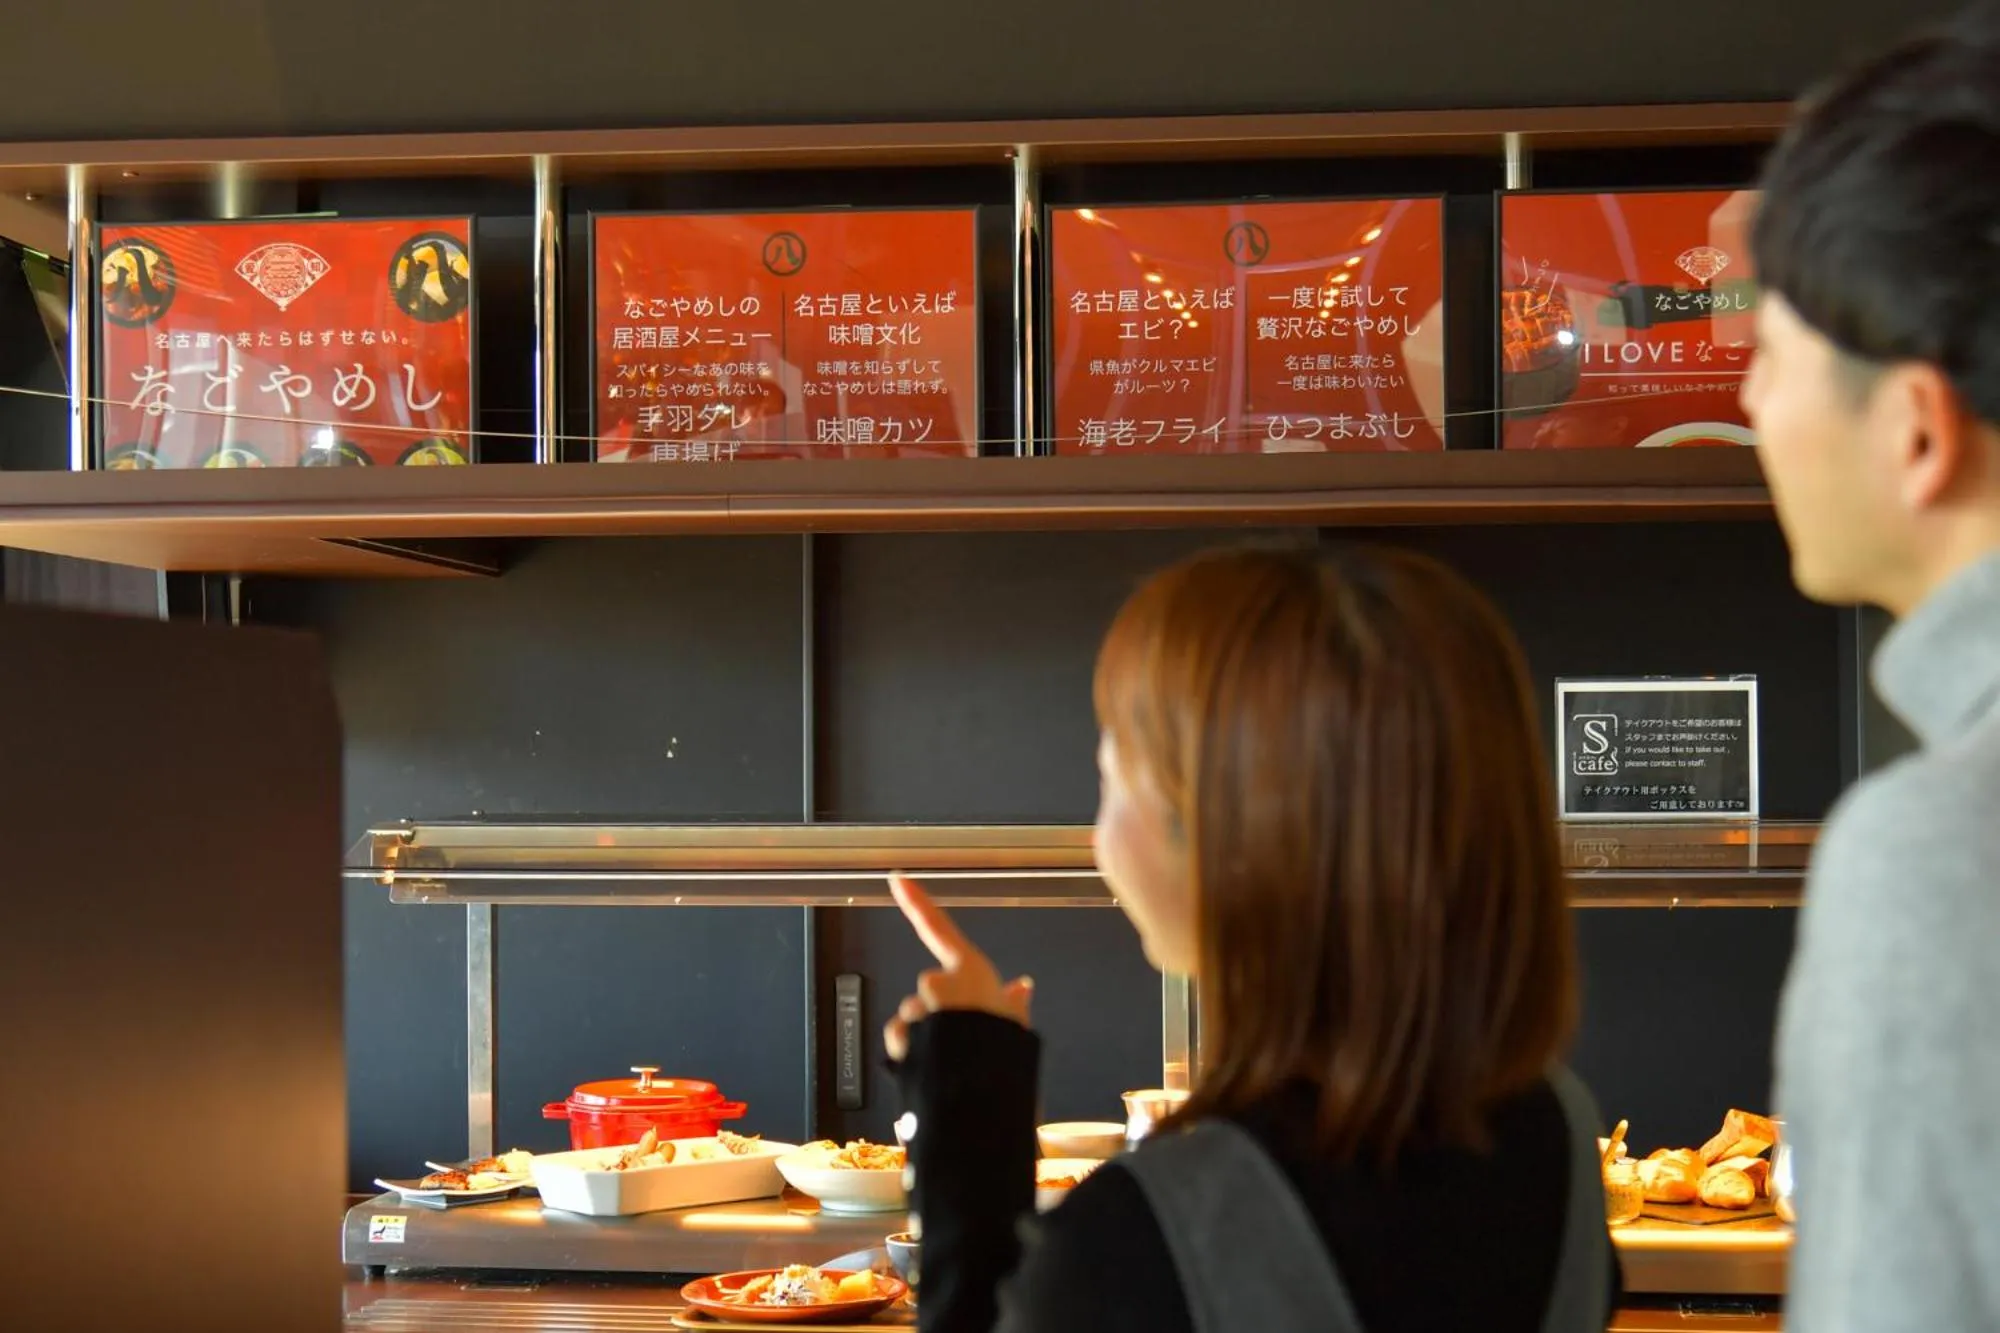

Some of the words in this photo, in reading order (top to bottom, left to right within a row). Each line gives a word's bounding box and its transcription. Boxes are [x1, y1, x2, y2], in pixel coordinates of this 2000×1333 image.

[623, 296, 761, 319] なごやめしの
[793, 290, 957, 318] 名古屋といえば
[1070, 286, 1236, 314] 名古屋といえば
[1268, 285, 1409, 310] 一度は試して
[1654, 292, 1749, 311] なごやめし
[612, 326, 772, 350] 居酒屋メニュー
[828, 322, 921, 347] 味噌文化
[1256, 315, 1421, 341] 贅沢なごやめし
[154, 331, 411, 350] 名古屋へ来たらはずせない。
[1284, 353, 1396, 371] 名古屋に来たら
[1584, 342, 1590, 364] I
[1603, 341, 1684, 364] LOVE
[616, 362, 772, 378] スパイシーなあの味を
[816, 359, 942, 376] 味噌を知らずして
[1089, 357, 1217, 376] 県魚がクルマエビ
[130, 362, 442, 417] なごやめし
[608, 383, 770, 399] 知ったらやめられない。
[803, 378, 948, 396] なごやめしは語れず。
[1277, 374, 1405, 391] 一度は味わいたい
[816, 416, 933, 445] 味噌カツ
[1078, 415, 1229, 448] 海老フライ
[1267, 411, 1415, 441] ひつまぶし
[1582, 720, 1609, 754] S
